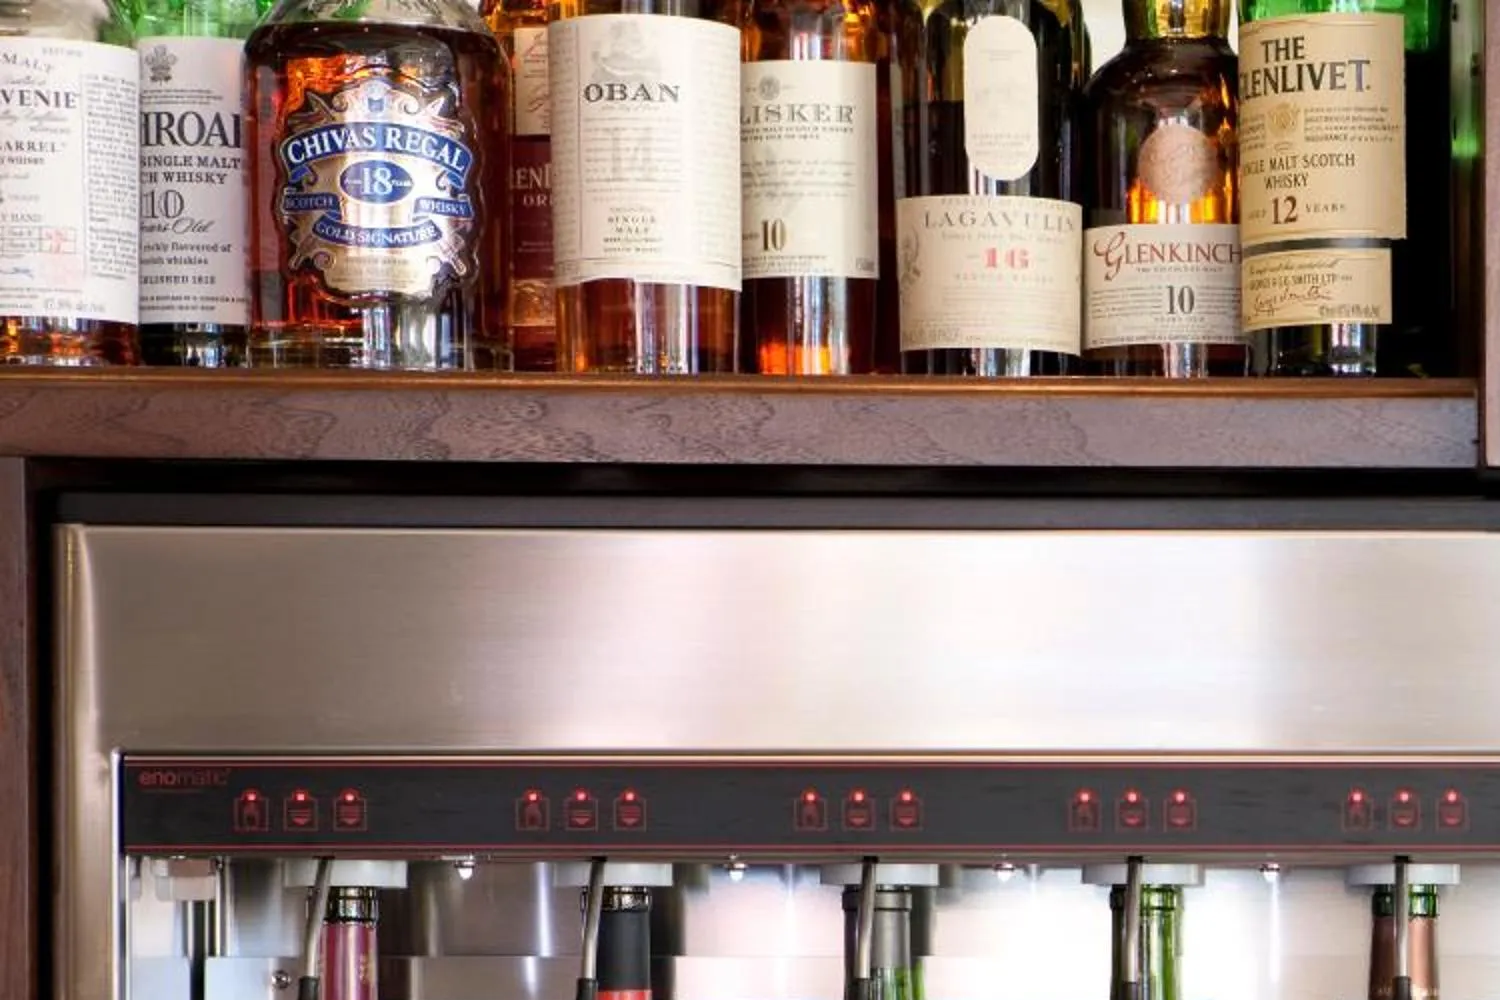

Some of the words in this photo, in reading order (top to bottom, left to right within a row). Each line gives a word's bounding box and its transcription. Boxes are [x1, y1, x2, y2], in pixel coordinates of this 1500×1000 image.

[1261, 36, 1305, 63] THE
[584, 83, 680, 103] OBAN
[287, 127, 376, 164] CHIVAS
[386, 127, 466, 172] REGAL
[197, 156, 241, 169] MALT
[1269, 155, 1298, 171] MALT
[1303, 153, 1355, 169] SCOTCH
[162, 172, 228, 185] WHISKY
[361, 166, 394, 196] 18
[1264, 173, 1309, 190] WHISKY
[285, 193, 335, 210] SCOTCH
[420, 199, 466, 215] WHISKY
[1271, 195, 1299, 225] 12
[316, 221, 356, 242] GOLD
[356, 224, 438, 245] SIGNATURE
[762, 218, 787, 251] 10
[983, 247, 1030, 269] 16
[1166, 284, 1195, 315] 10
[140, 768, 227, 787] enomatic
